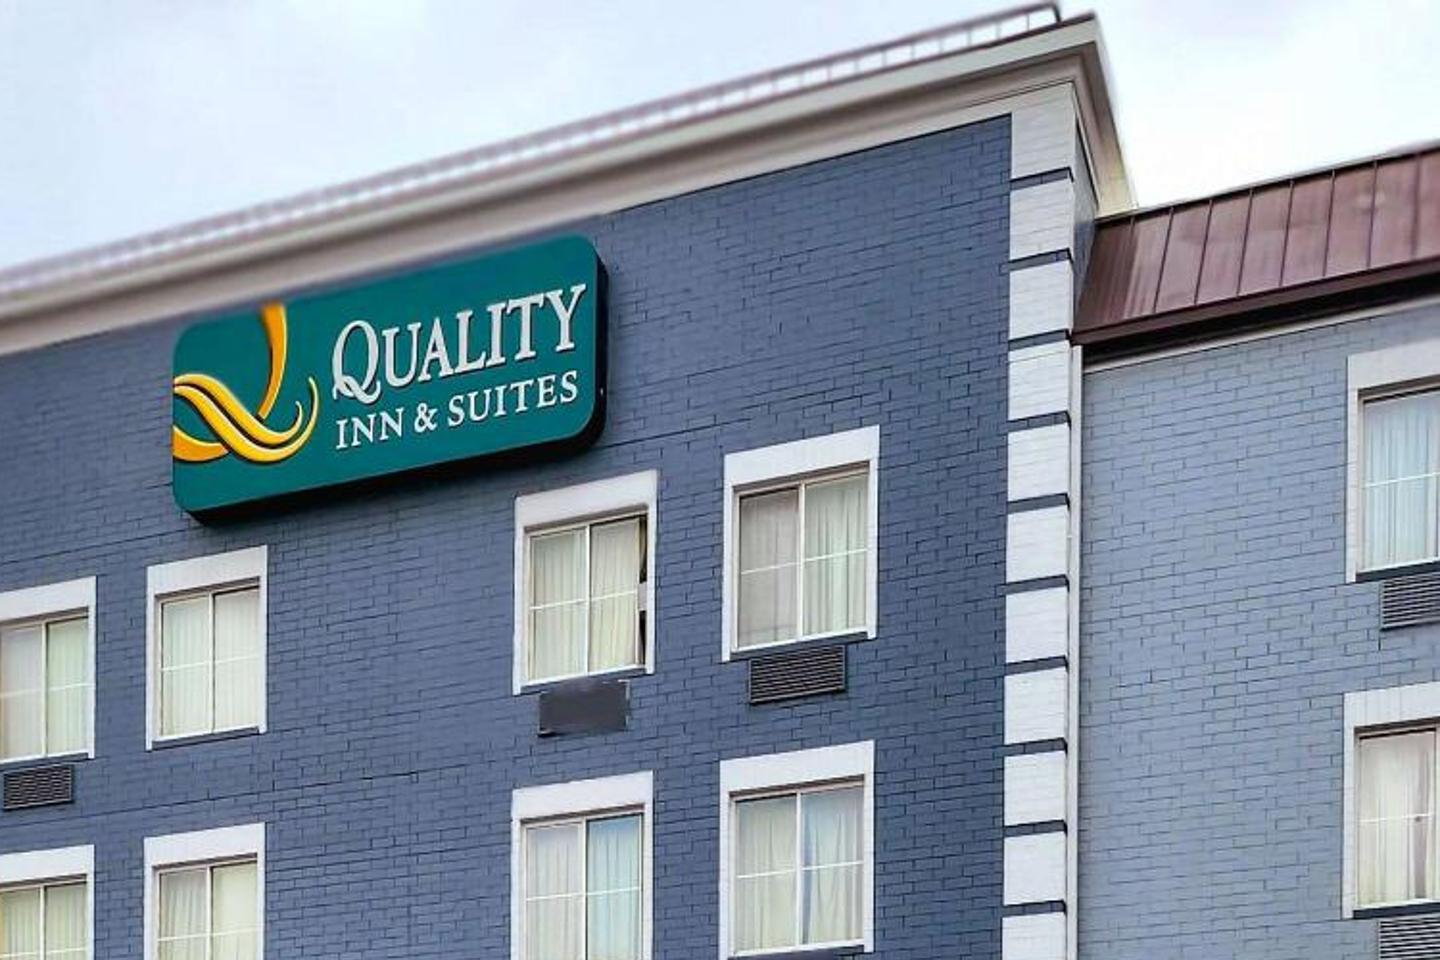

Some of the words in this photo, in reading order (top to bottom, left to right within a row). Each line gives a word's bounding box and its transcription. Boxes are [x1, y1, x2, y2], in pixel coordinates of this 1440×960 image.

[332, 283, 587, 404] QUALITY
[336, 407, 404, 450] INN
[413, 403, 439, 433] &
[447, 371, 579, 427] SUITES
